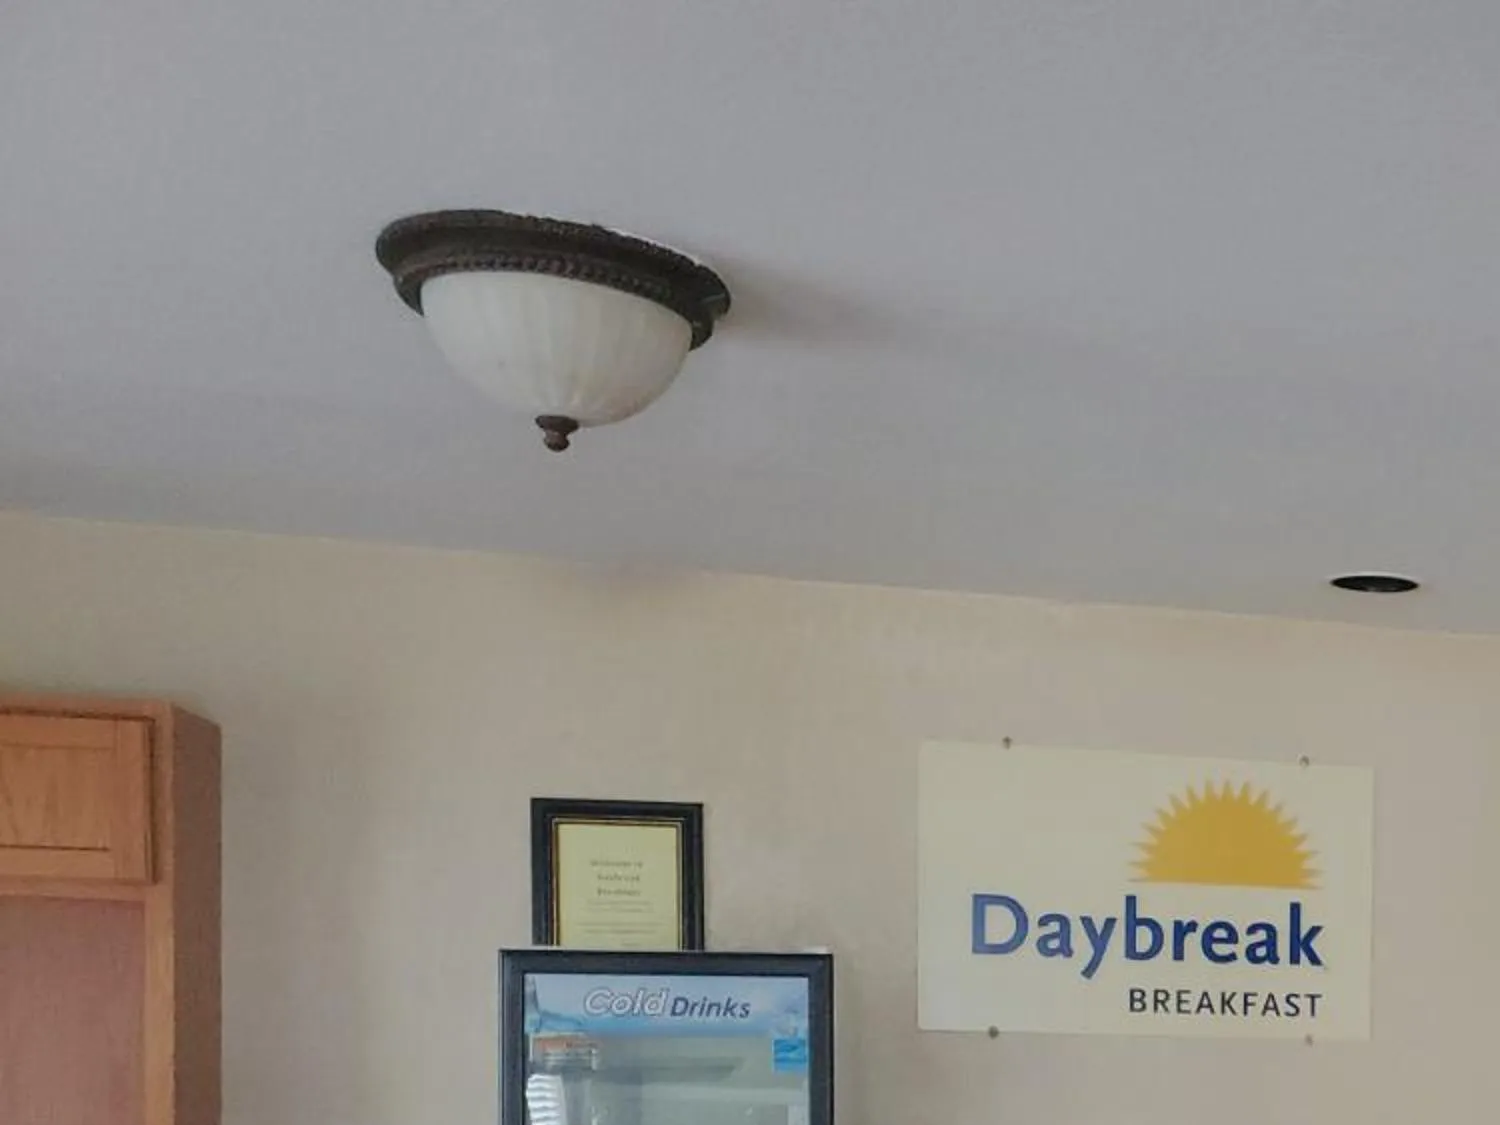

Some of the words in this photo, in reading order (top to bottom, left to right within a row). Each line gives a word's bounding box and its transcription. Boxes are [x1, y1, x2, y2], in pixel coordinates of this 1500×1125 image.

[970, 893, 1324, 980] Daybreak
[584, 986, 670, 1018] Cold
[669, 996, 752, 1020] Drinks
[1128, 988, 1323, 1018] BREAKFAST
